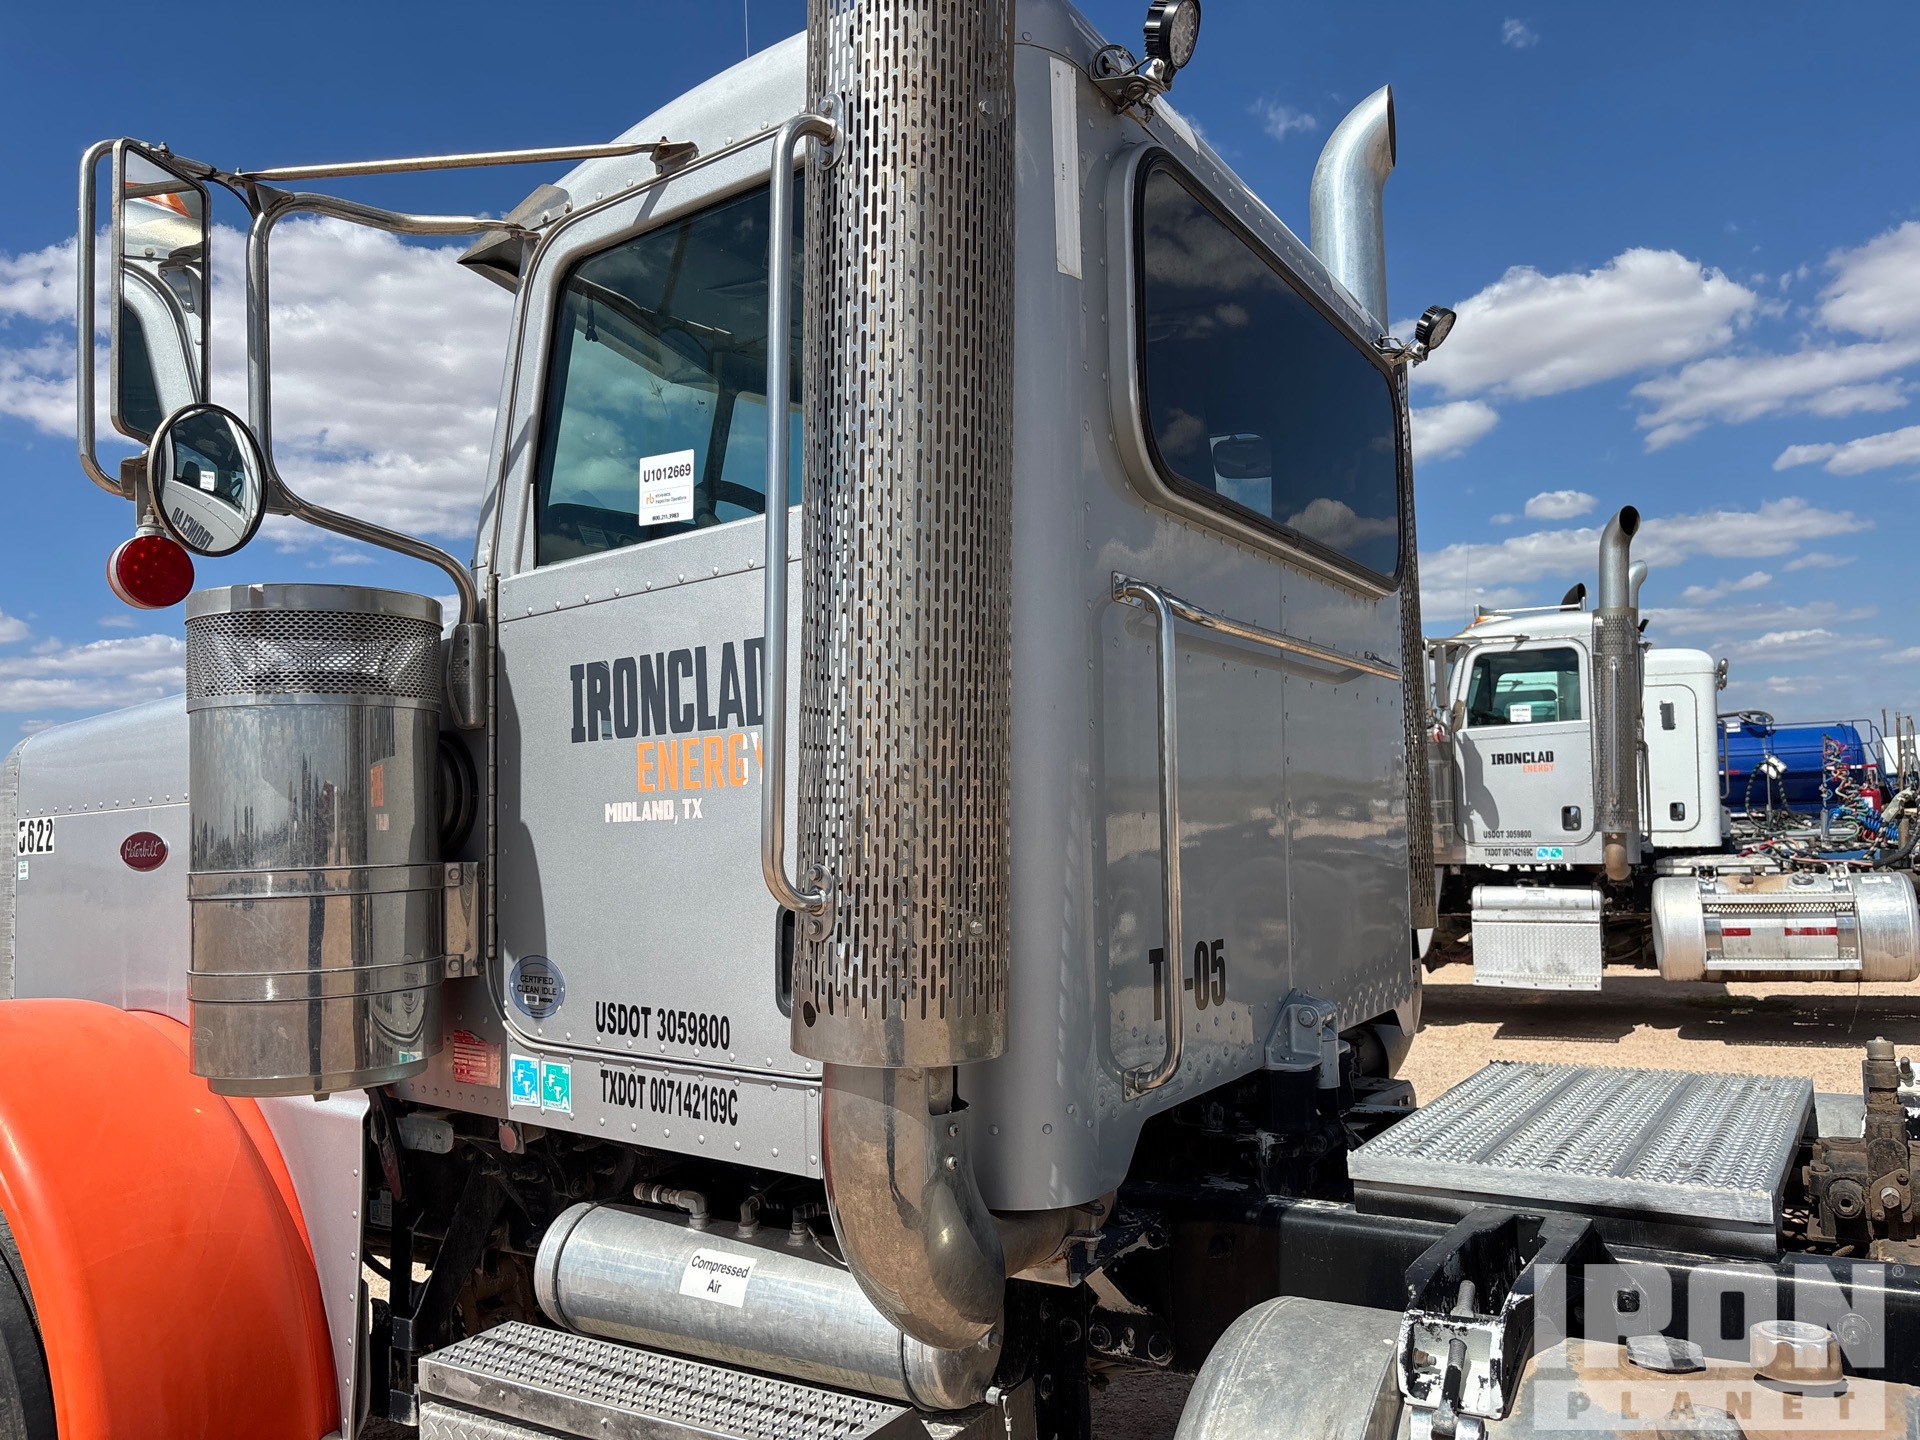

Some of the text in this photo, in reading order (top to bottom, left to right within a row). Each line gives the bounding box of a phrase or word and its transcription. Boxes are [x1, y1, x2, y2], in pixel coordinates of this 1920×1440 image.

[643, 463, 691, 483] U1012669
[570, 637, 764, 743] IRONCLAD
[1491, 750, 1554, 765] IRONCLAD
[1522, 763, 1555, 773] ENERGY
[604, 797, 703, 825] MIDLAND, TX
[18, 818, 53, 853] 5622
[1483, 830, 1504, 839] USDOT
[124, 839, 162, 860] Peterbilt
[1484, 848, 1501, 857] TXDOT
[520, 974, 554, 985] CERTIFIED
[517, 984, 557, 996] CLEAN IDLE
[595, 1001, 730, 1050] USDOT 3059800
[600, 1069, 738, 1127] TXDOT 007142169C
[691, 1255, 750, 1279] Compressed
[707, 1279, 722, 1294] Air
